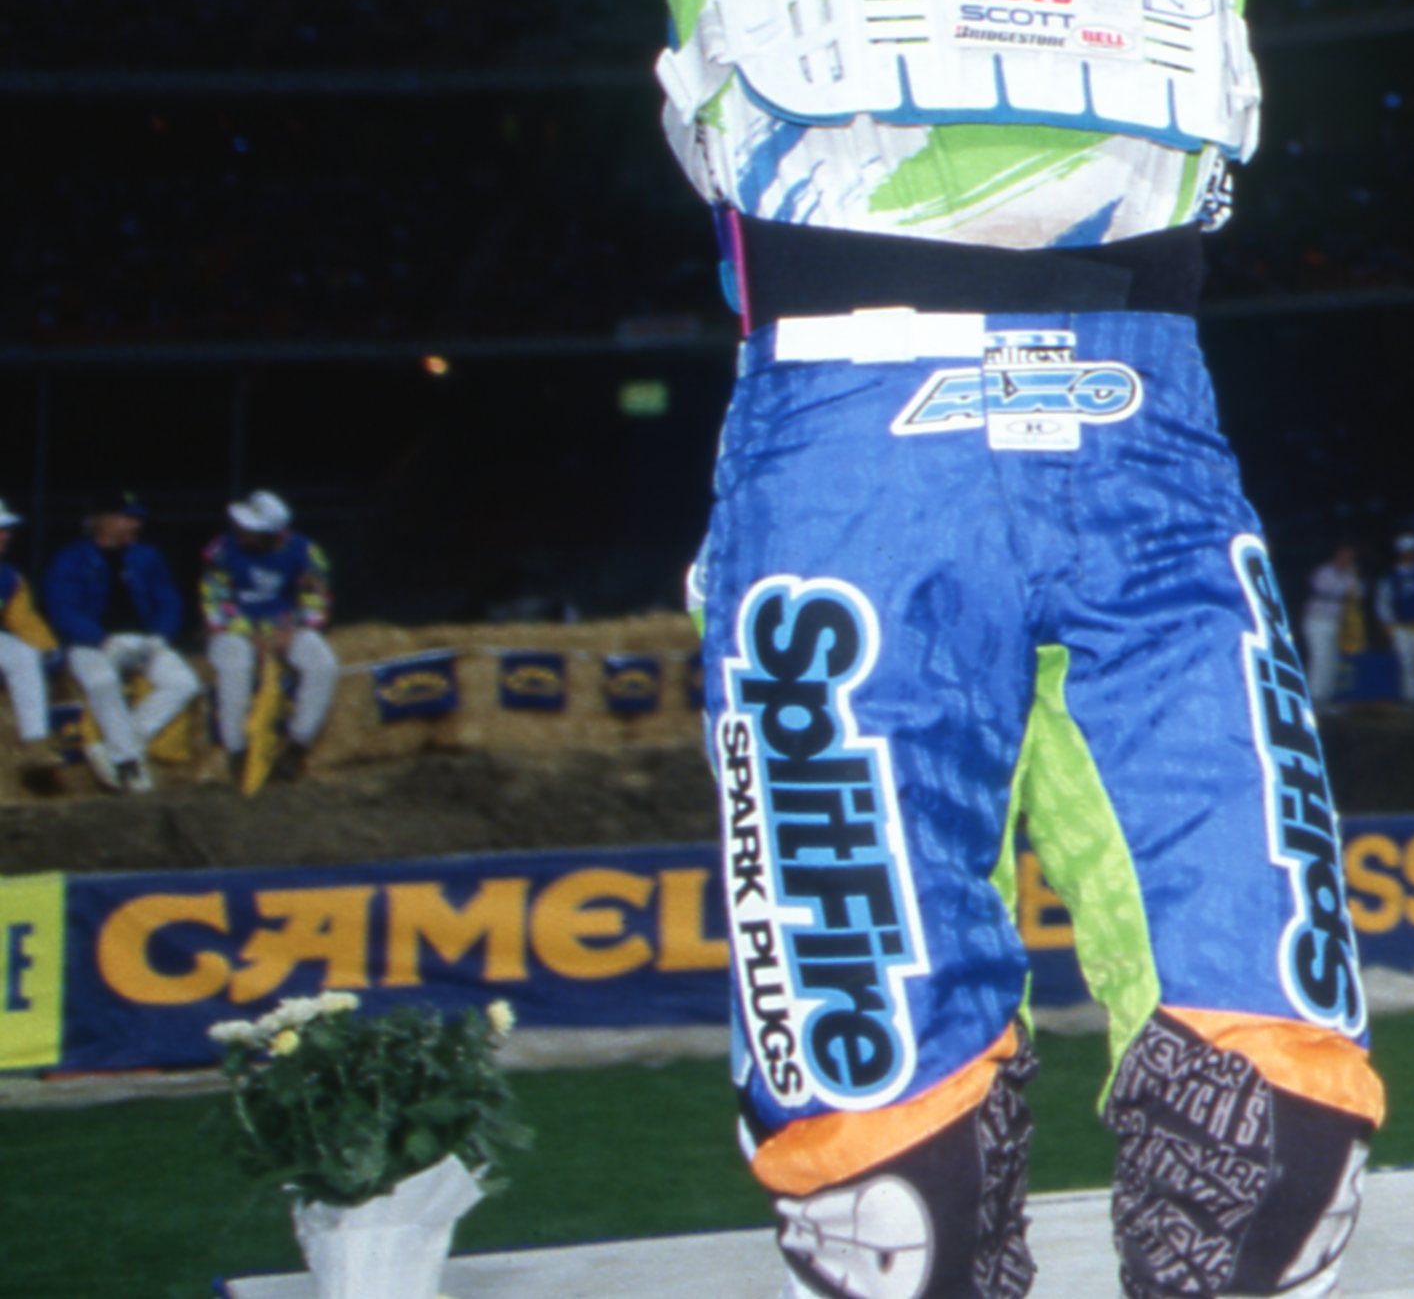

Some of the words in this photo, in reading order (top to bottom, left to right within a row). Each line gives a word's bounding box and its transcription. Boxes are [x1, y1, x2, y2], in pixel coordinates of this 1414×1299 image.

[954, 25, 1067, 47] BRIDGESTONE
[959, 3, 1076, 29] SCOTT
[1081, 29, 1126, 47] BELL
[721, 719, 784, 905] SPARK
[736, 585, 917, 1097] SplitFire
[96, 867, 730, 1005] CAMEL
[741, 920, 802, 1098] PLUGS
